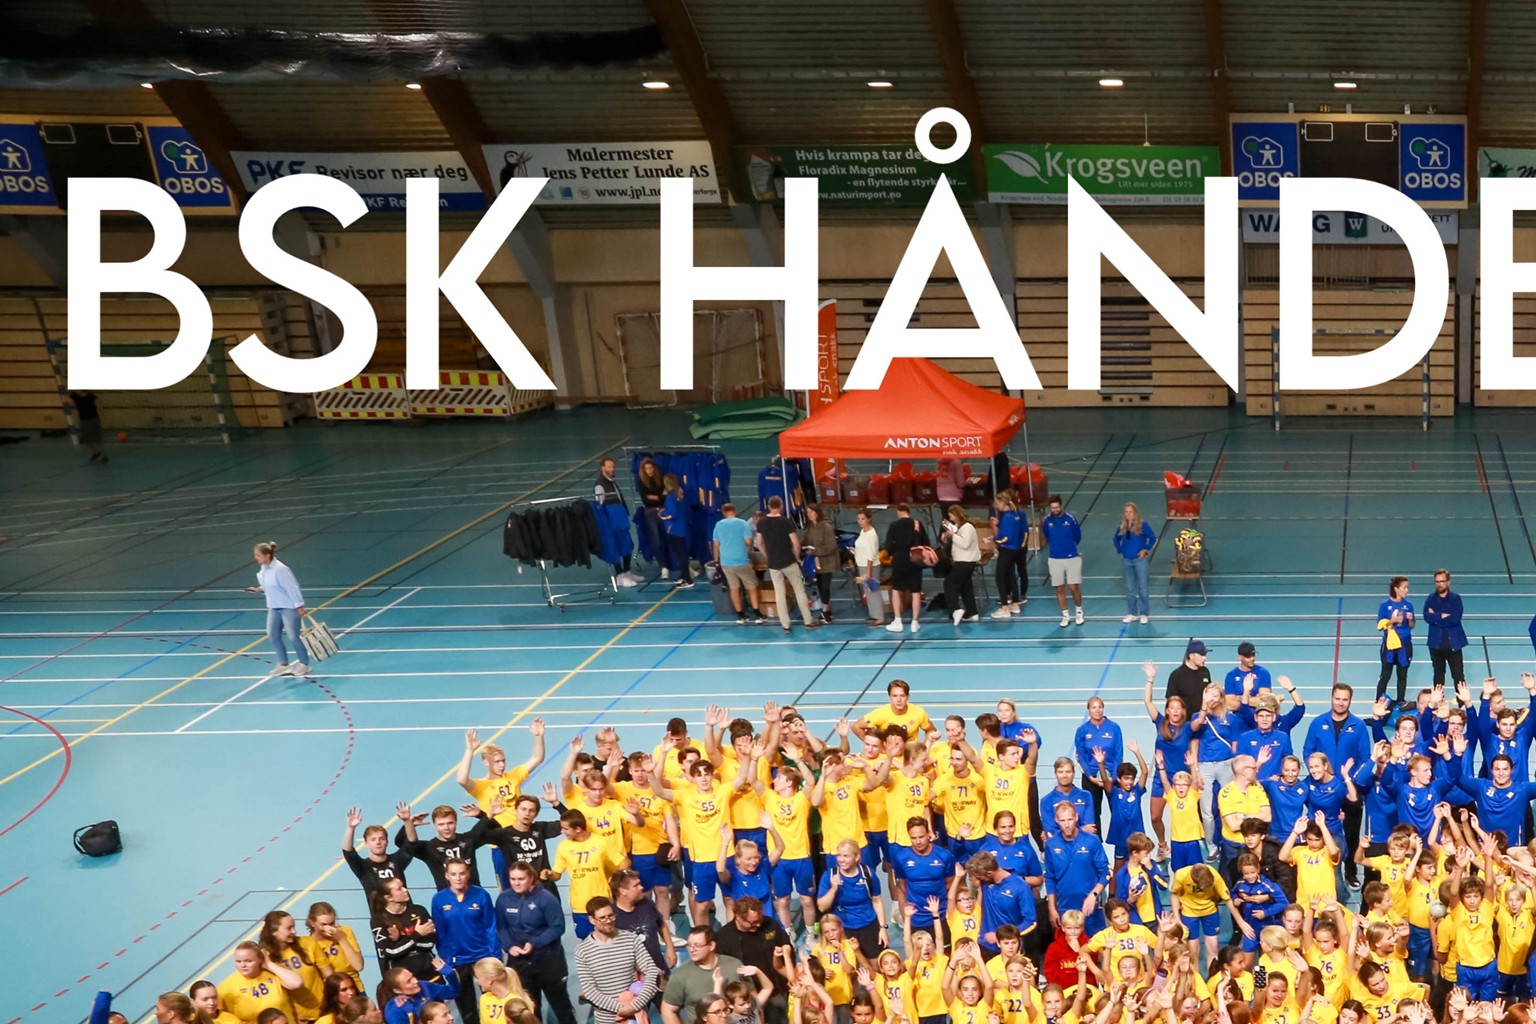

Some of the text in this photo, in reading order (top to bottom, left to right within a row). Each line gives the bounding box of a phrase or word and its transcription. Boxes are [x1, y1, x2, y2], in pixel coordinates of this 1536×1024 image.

[566, 147, 674, 162] Malermester
[795, 150, 825, 161] Hvis
[828, 150, 879, 162] krampa
[882, 150, 902, 160] tar
[316, 164, 468, 181] Revisor nær deg
[542, 165, 709, 181] Jens Petter Lunde AS
[798, 166, 917, 177] Floradix Magnesium
[1045, 152, 1202, 184] Krogsveen
[165, 177, 224, 194] OBOS
[867, 178, 908, 187] flytende
[911, 178, 937, 187] styrk
[1405, 173, 1461, 189] OBOS
[1249, 214, 1331, 233] WG
[958, 786, 969, 798] 71
[701, 801, 715, 812] 55
[780, 804, 793, 815] 53
[519, 838, 537, 851] 60
[445, 847, 461, 859] 97
[577, 851, 590, 864] 77
[1118, 937, 1135, 951] 38
[828, 951, 841, 964] 18
[251, 983, 269, 998] 48
[1007, 998, 1023, 1014] 22
[1376, 1005, 1391, 1020] 33
[966, 1011, 974, 1024] 2
